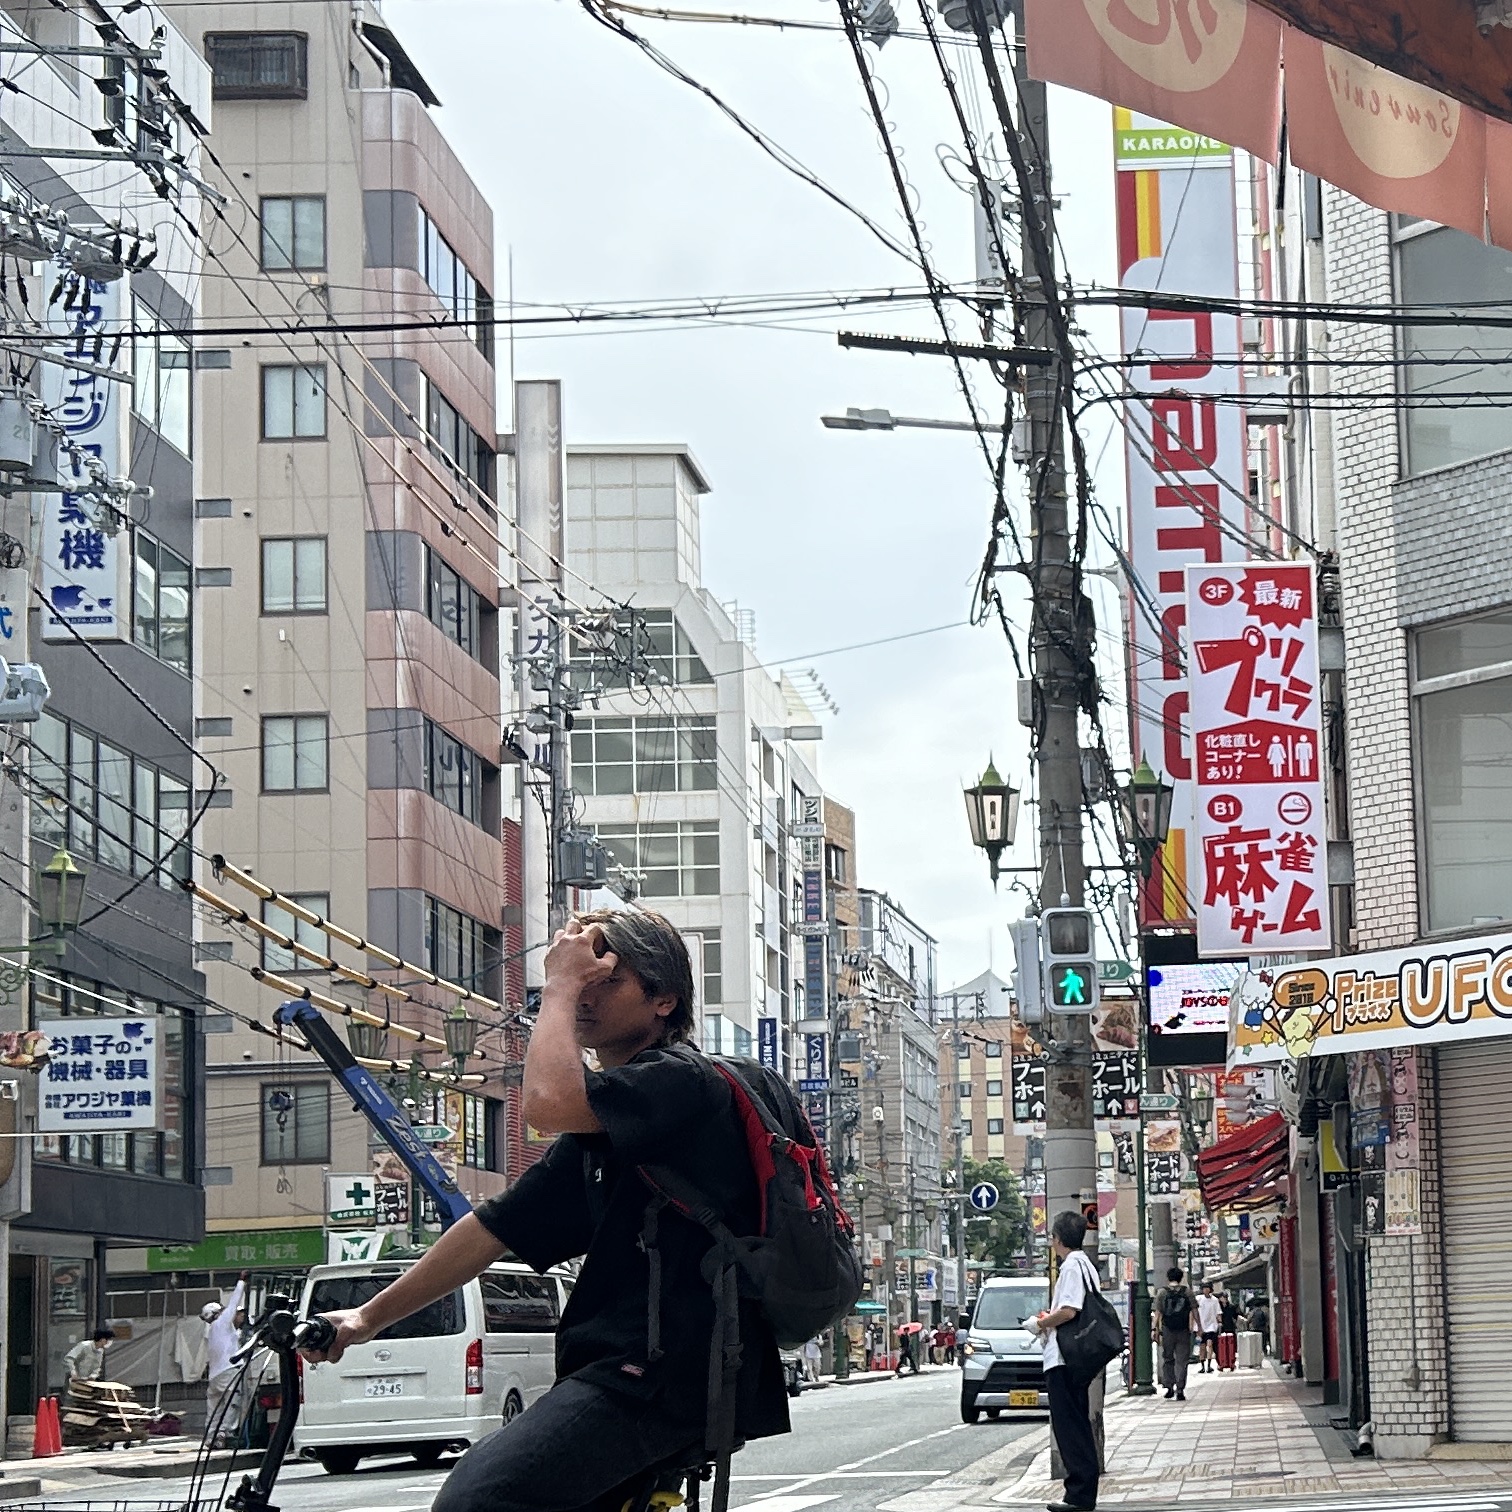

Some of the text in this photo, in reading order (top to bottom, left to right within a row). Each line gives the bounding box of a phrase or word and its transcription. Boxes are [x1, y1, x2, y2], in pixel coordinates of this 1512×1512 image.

[1122, 135, 1222, 152] KARAOKE
[1204, 584, 1228, 600] 3F
[1252, 579, 1303, 611] 最新
[1192, 624, 1314, 722] プリクラ
[1203, 732, 1262, 749] 化粧直し
[1204, 749, 1262, 764] コーナー
[1206, 764, 1243, 780] あり!
[1213, 801, 1236, 817] B1
[1202, 825, 1319, 908] 麻雀
[1230, 879, 1323, 945] ゲーム
[1335, 973, 1399, 1030] Prize
[47, 1034, 132, 1057] お菓子の
[47, 1058, 149, 1083] 機械・器具
[1092, 1057, 1137, 1080] フード
[1092, 1076, 1140, 1099] ホール
[385, 1113, 427, 1165] Zest
[375, 1185, 406, 1202] フード
[376, 1198, 409, 1214] ホール
